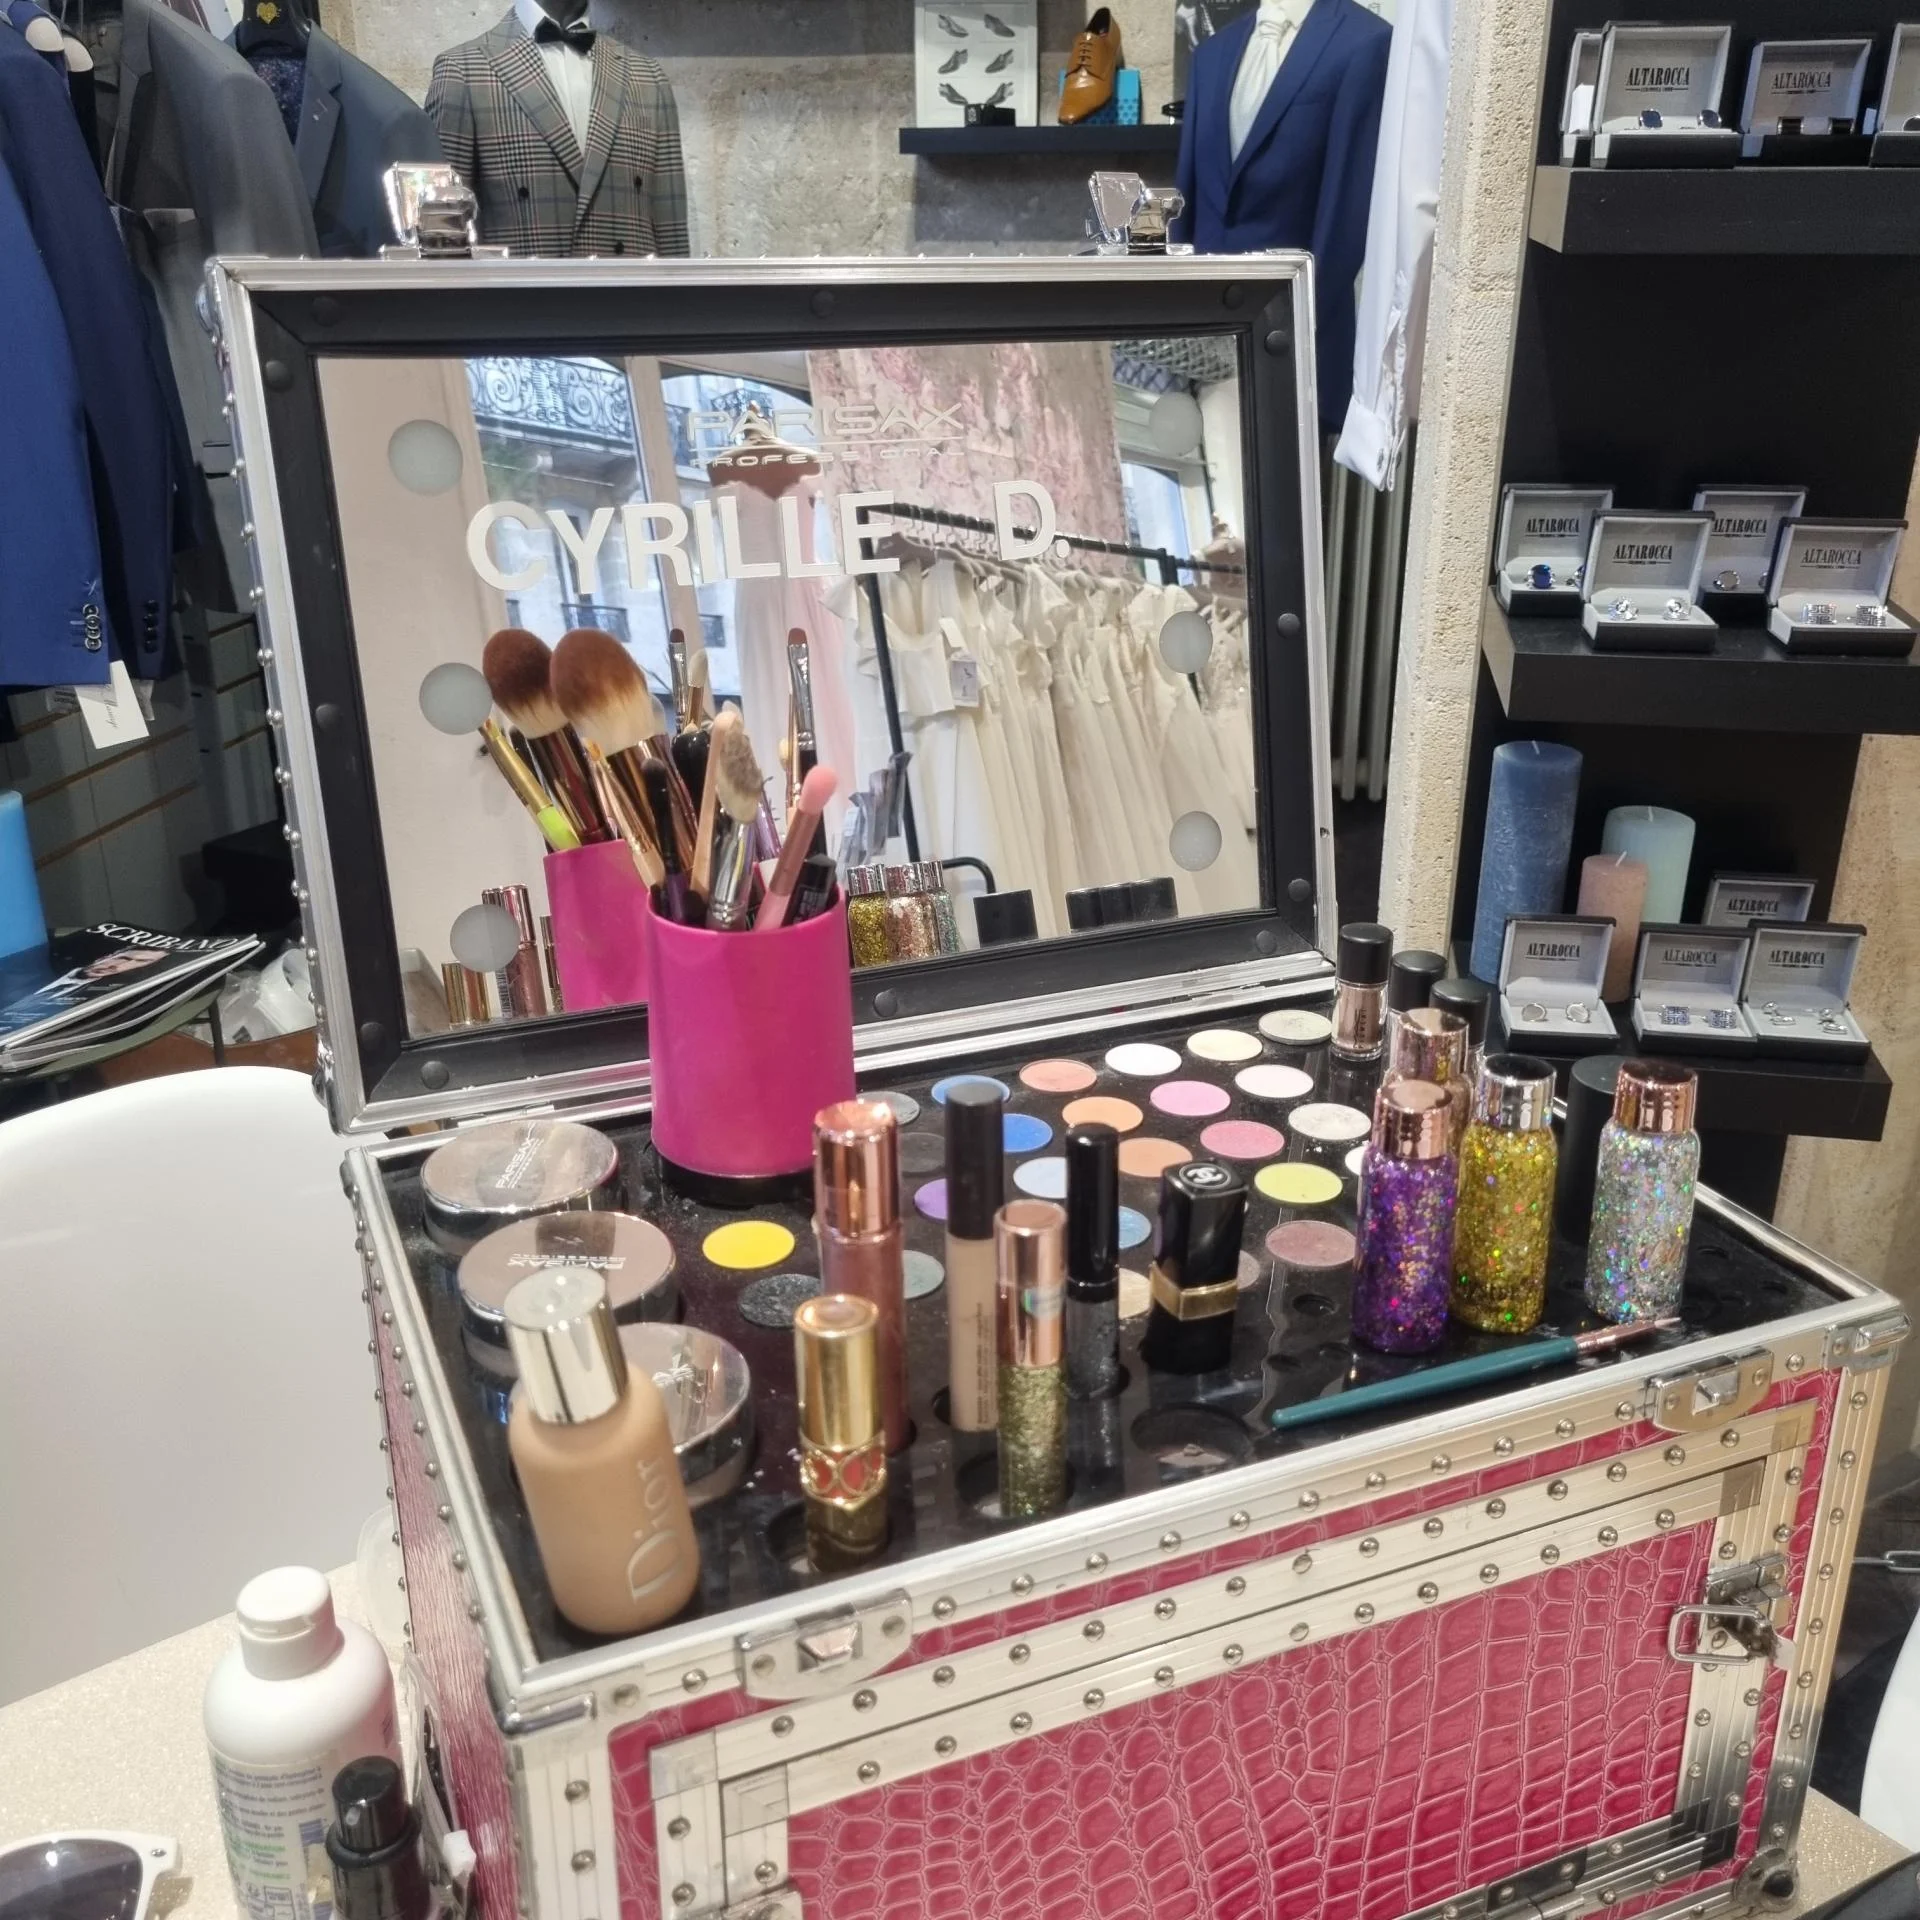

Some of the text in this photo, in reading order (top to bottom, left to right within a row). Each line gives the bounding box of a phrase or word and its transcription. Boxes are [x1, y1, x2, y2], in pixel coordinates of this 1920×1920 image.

[1626, 67, 1690, 86] ALTAROCCA
[1771, 71, 1831, 89] ALTAROCCA
[688, 402, 964, 441] PARISAX
[690, 447, 965, 468] PROFESSONAL
[1526, 517, 1580, 533] ALTAROCCA
[1712, 518, 1767, 533] ALTAROCCA
[466, 479, 1072, 594] CYRILLE D.
[1613, 544, 1673, 560] ALTAROCCA
[1802, 549, 1862, 565] ALTAROCCA
[1728, 898, 1778, 912] ALTAROCCA
[1526, 942, 1581, 958] ALTAROCCA
[1662, 949, 1717, 964] ALTAROCCA
[1769, 950, 1825, 965] ALTAROCCA
